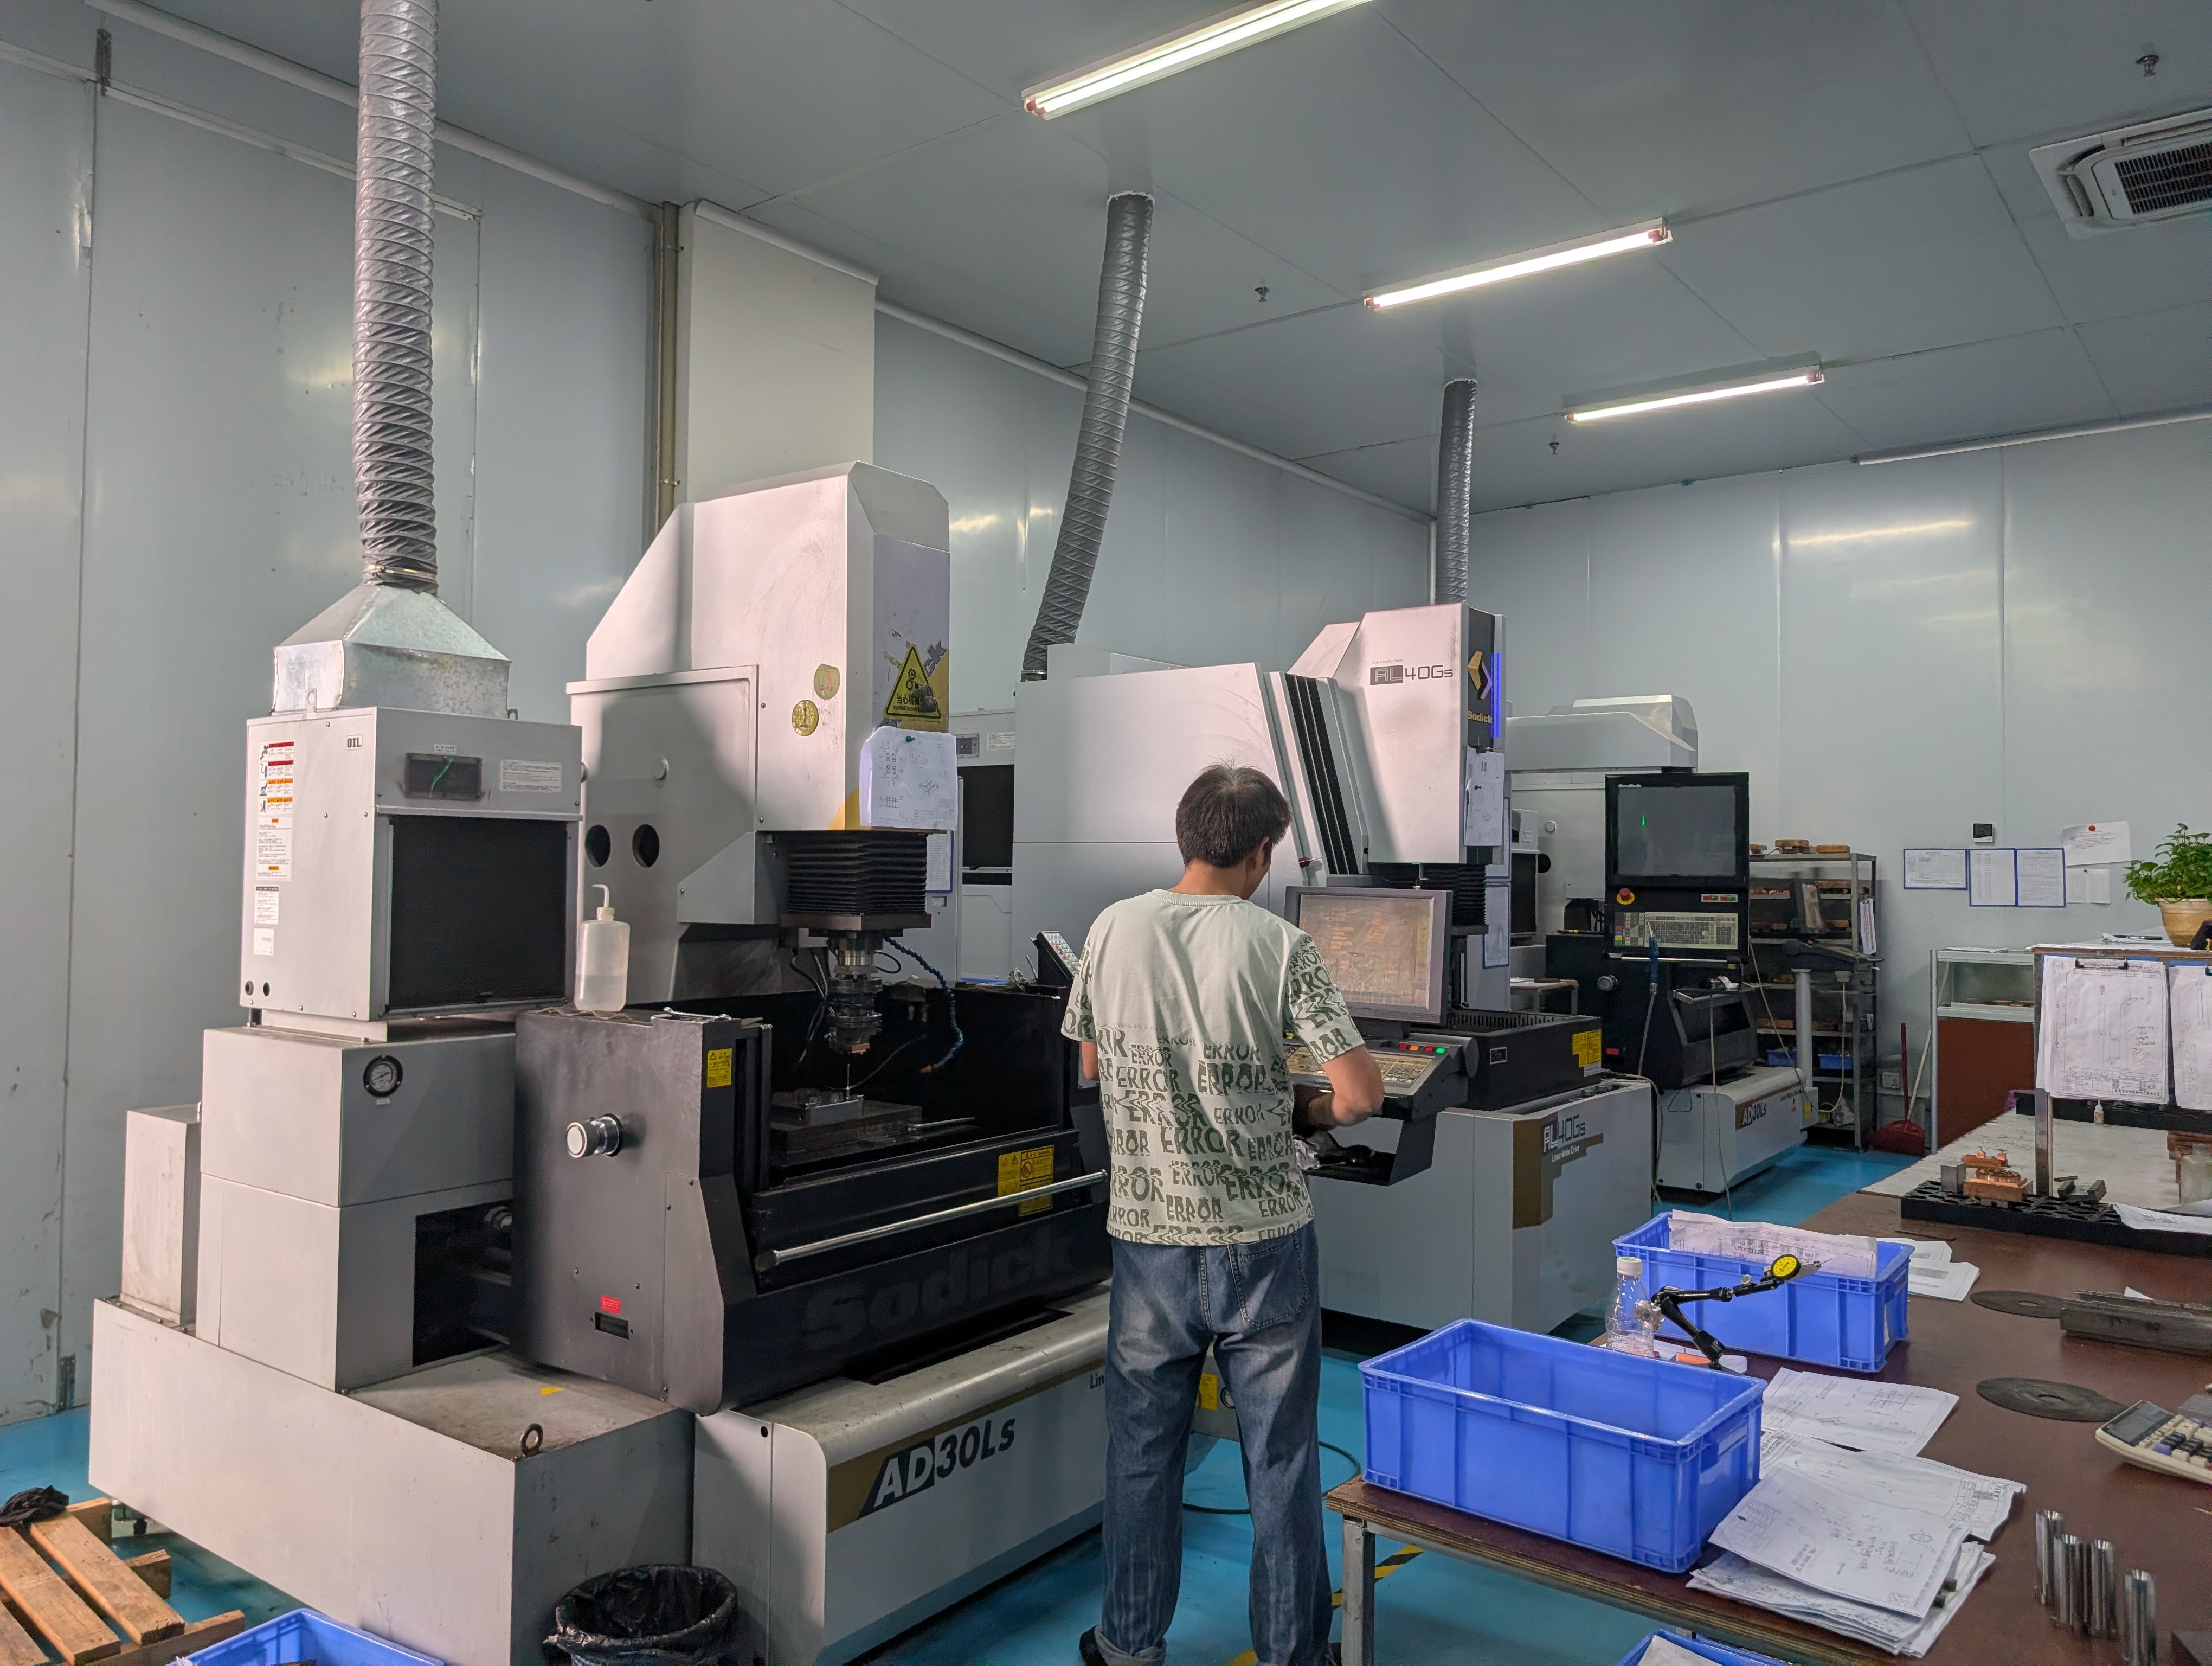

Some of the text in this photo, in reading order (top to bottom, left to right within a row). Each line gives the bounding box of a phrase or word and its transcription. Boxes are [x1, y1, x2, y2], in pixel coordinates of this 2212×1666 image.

[1468, 711, 1493, 723] Sodick
[347, 737, 361, 748] OIL
[1199, 1041, 1261, 1061] ERROR
[1116, 1066, 1182, 1092] ERROR
[1214, 1103, 1265, 1124] ERROR
[1161, 1126, 1245, 1157] ERROR
[1166, 1194, 1224, 1223] ERROR
[1258, 1191, 1304, 1218] ERROR
[803, 1225, 1074, 1350] Sodick
[1090, 1373, 1104, 1389] Lin
